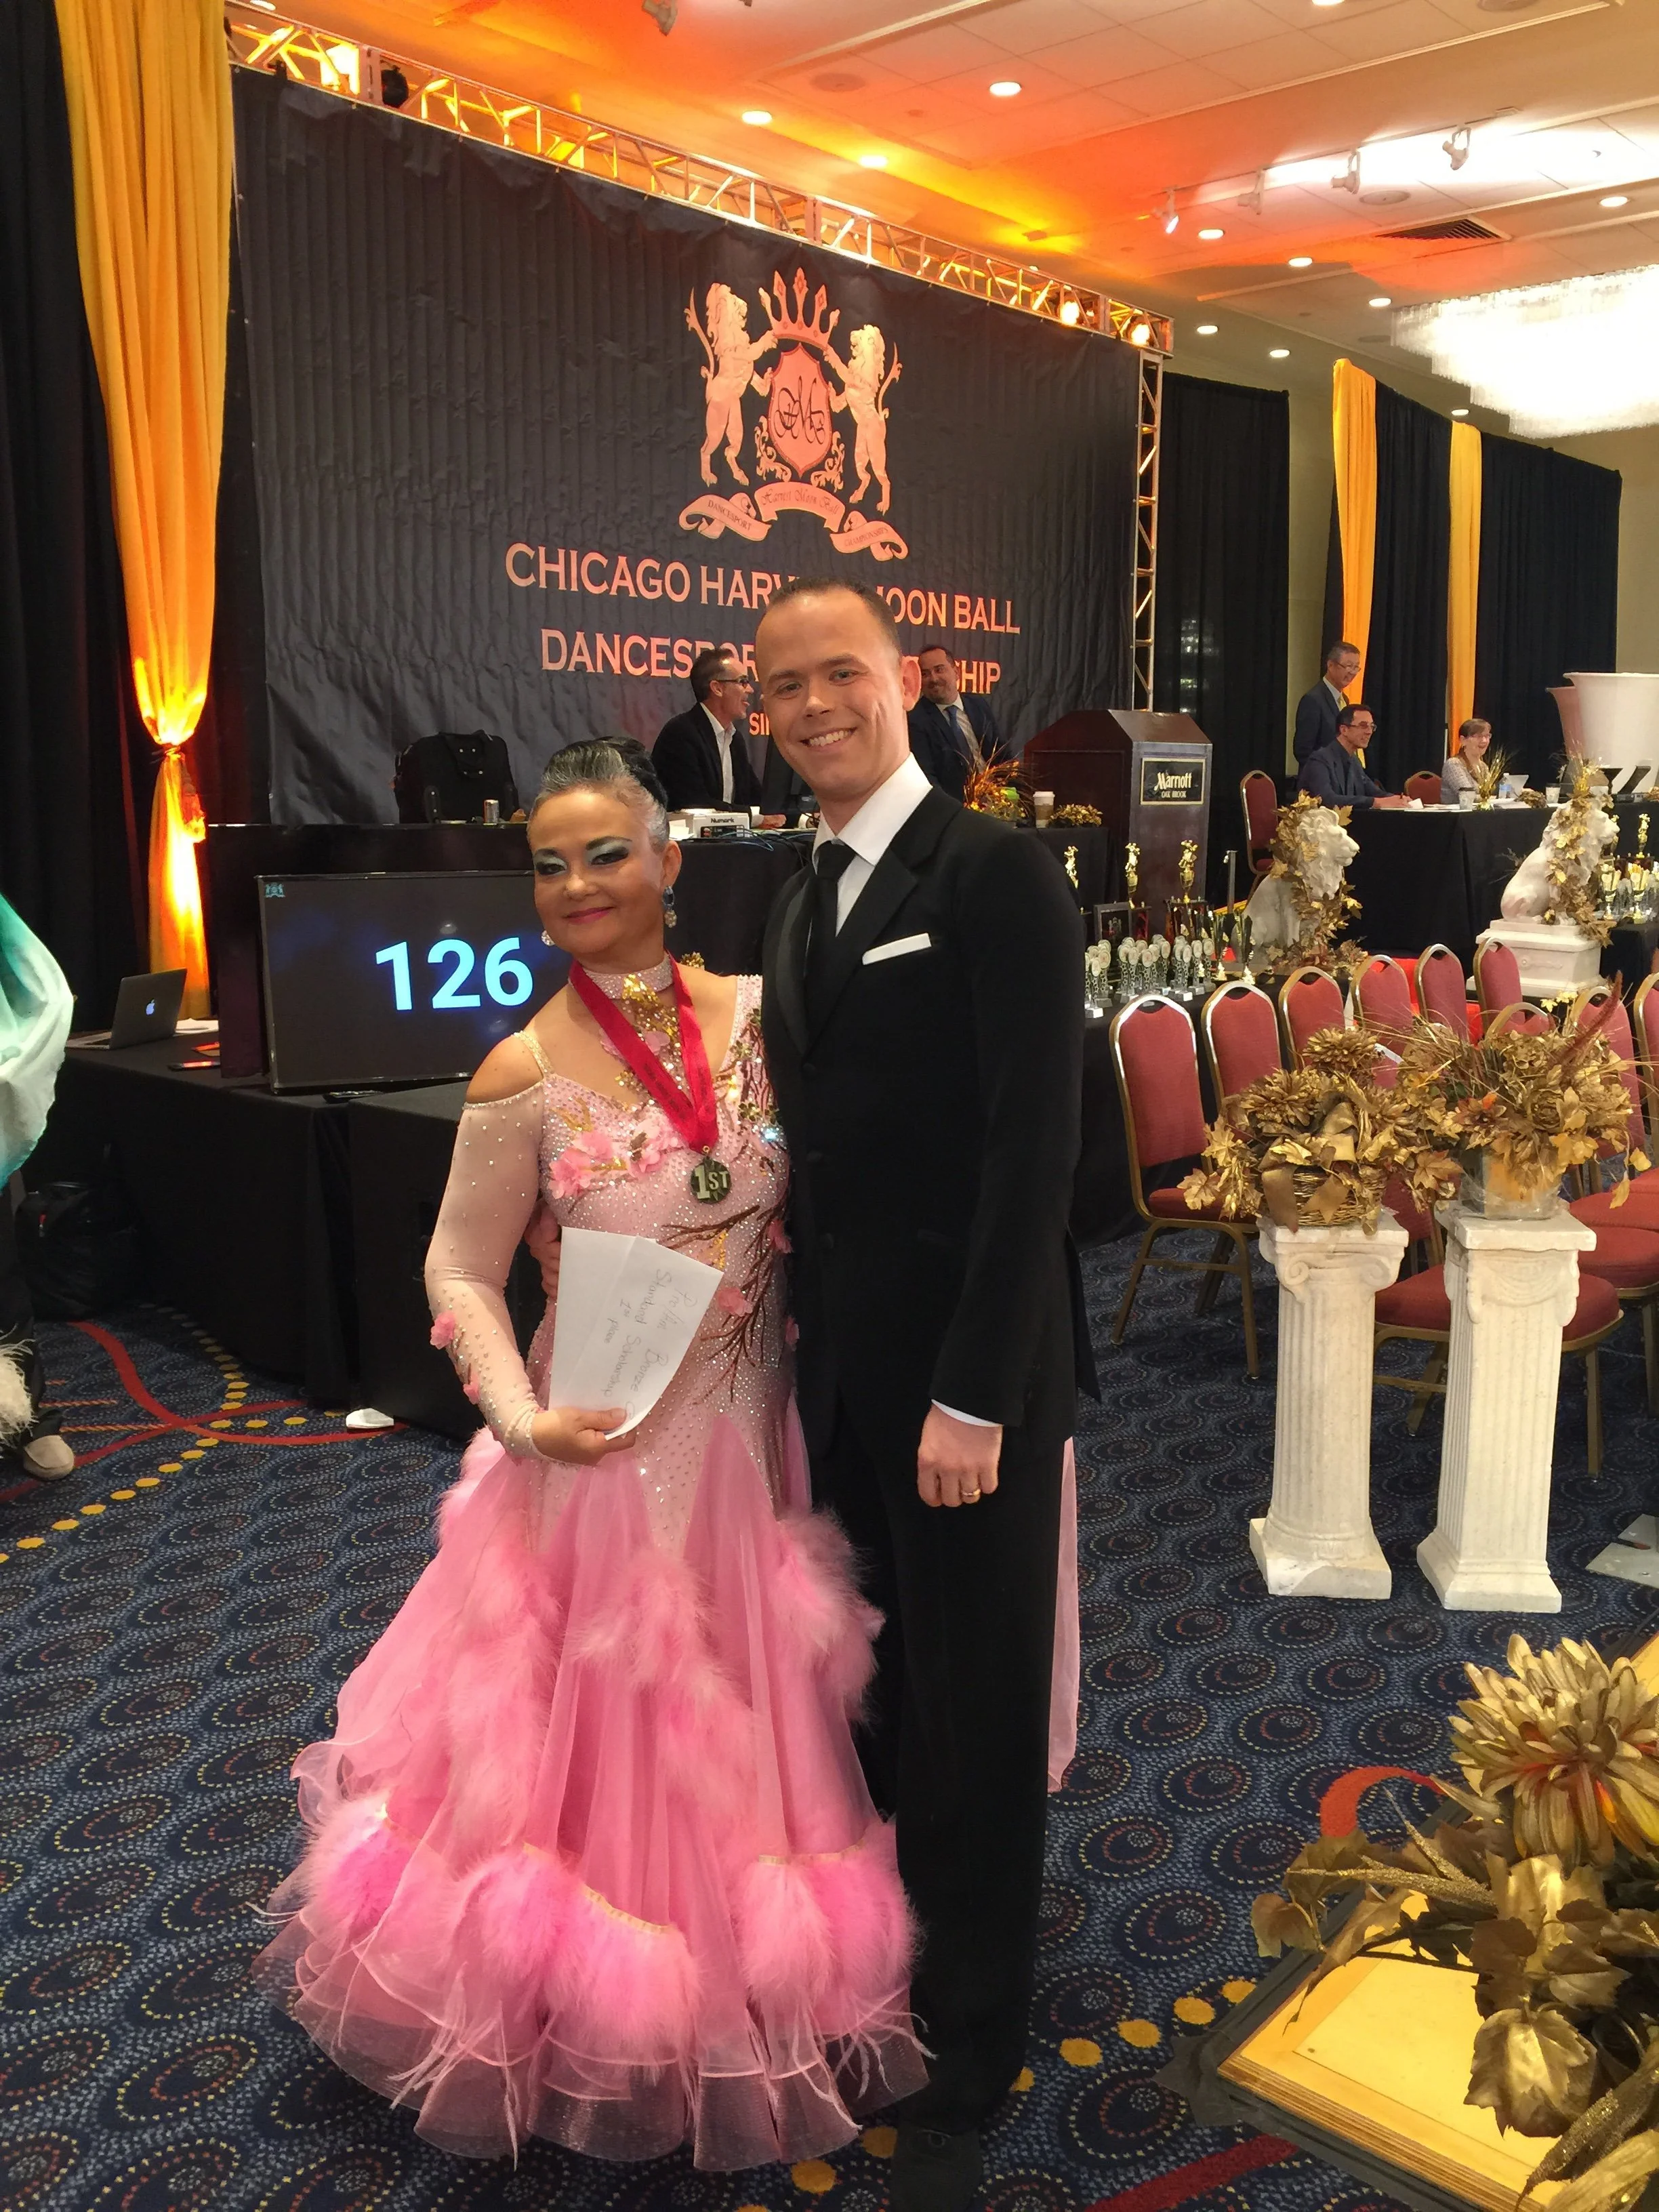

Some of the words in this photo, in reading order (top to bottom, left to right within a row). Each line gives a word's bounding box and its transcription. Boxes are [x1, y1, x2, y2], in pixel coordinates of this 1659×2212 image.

[707, 499, 753, 532] DANCESPORT
[505, 542, 691, 602] CHICAGO
[876, 586, 947, 628] OON
[954, 594, 1021, 634] BALL
[1153, 772, 1192, 791] Marriott
[375, 937, 534, 1010] 126
[695, 1165, 729, 1199] 1ST
